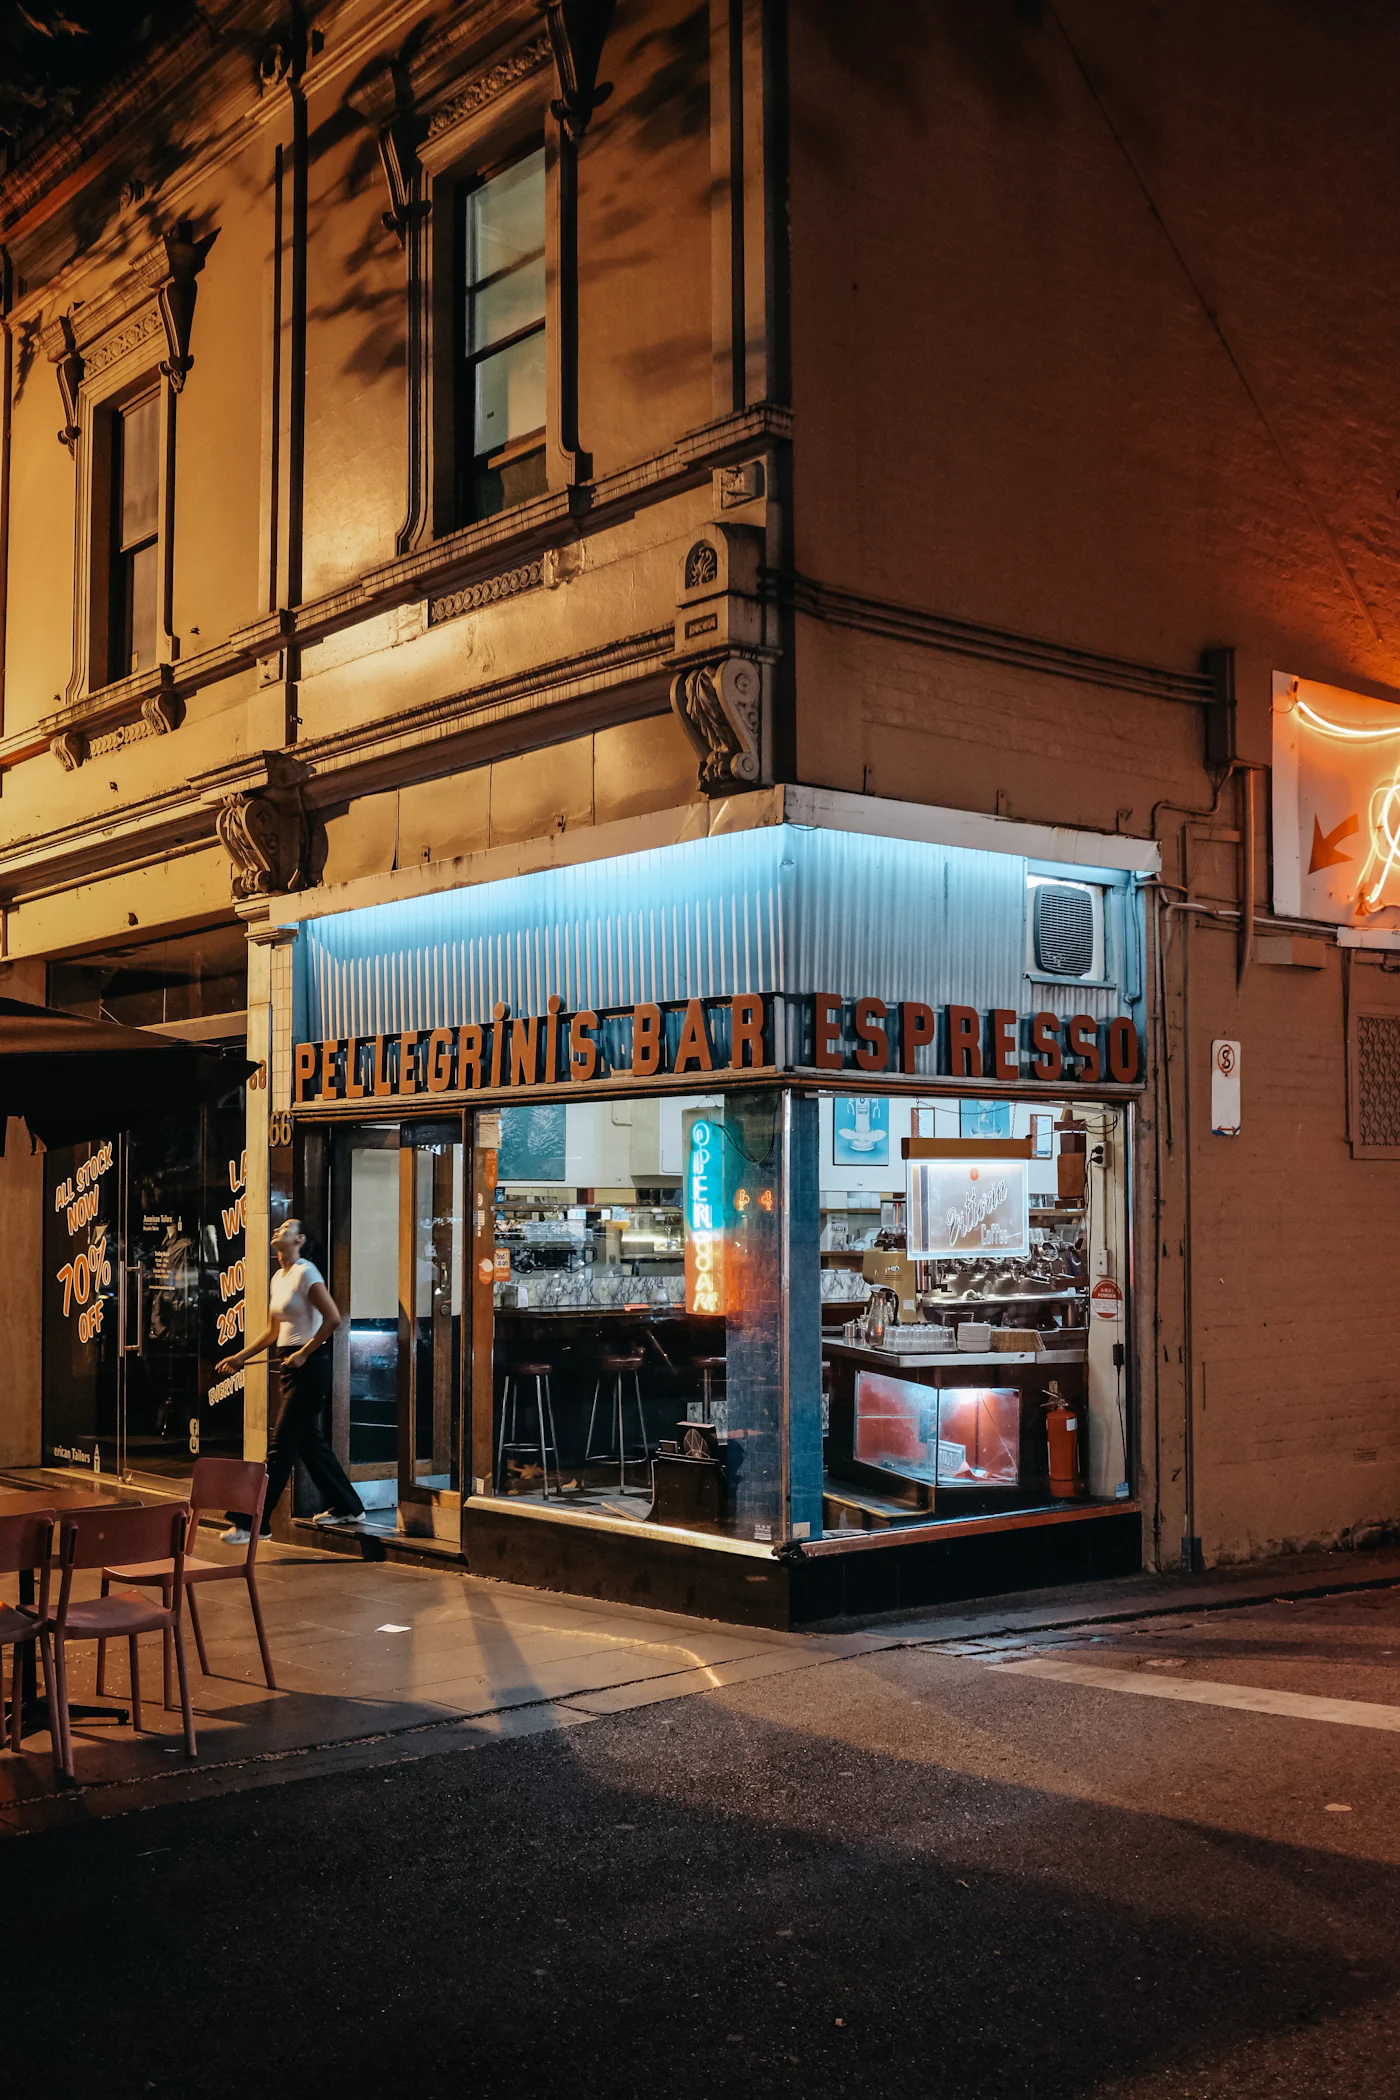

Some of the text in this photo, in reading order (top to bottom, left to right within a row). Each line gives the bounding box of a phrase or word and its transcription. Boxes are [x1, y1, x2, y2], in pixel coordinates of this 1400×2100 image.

[632, 993, 763, 1077] BAR
[814, 992, 1139, 1083] ESPRESSO
[269, 1110, 291, 1146] 66
[55, 1141, 113, 1213] ALL STOCK
[692, 1122, 712, 1229] OPEN
[67, 1183, 99, 1236] NOW
[980, 1222, 1009, 1245] Coffee
[57, 1236, 112, 1317] 70%
[219, 1256, 246, 1302] MO
[78, 1299, 104, 1343] OFF
[71, 1447, 91, 1464] Tailors
